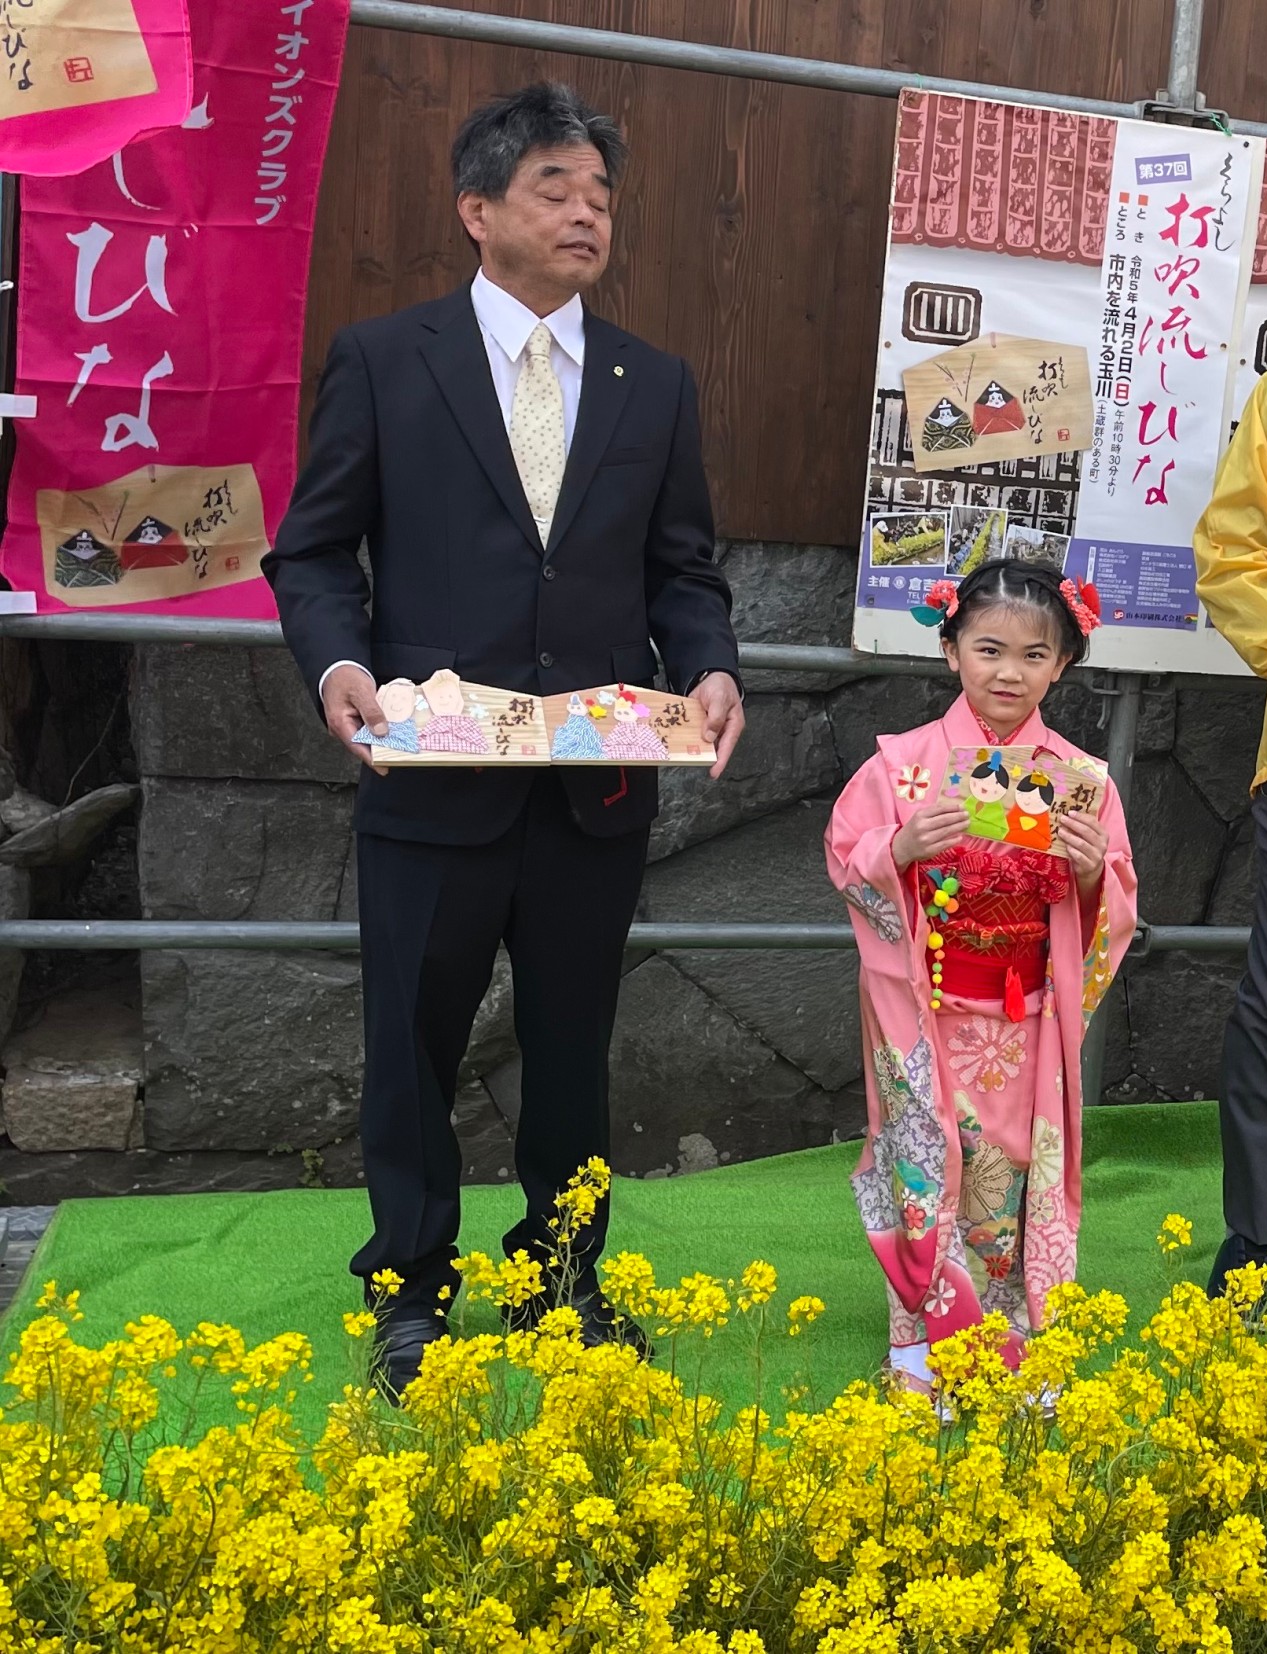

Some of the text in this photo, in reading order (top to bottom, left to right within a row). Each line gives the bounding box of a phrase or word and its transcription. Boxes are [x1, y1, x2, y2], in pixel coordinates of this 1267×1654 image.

[254, 0, 315, 225] イオンズクラブ
[1139, 161, 1188, 179] 第37回
[67, 92, 214, 452] しびな
[1115, 206, 1128, 241] ところ
[1131, 192, 1216, 505] 打吹流しびな
[868, 575, 890, 588] 主催
